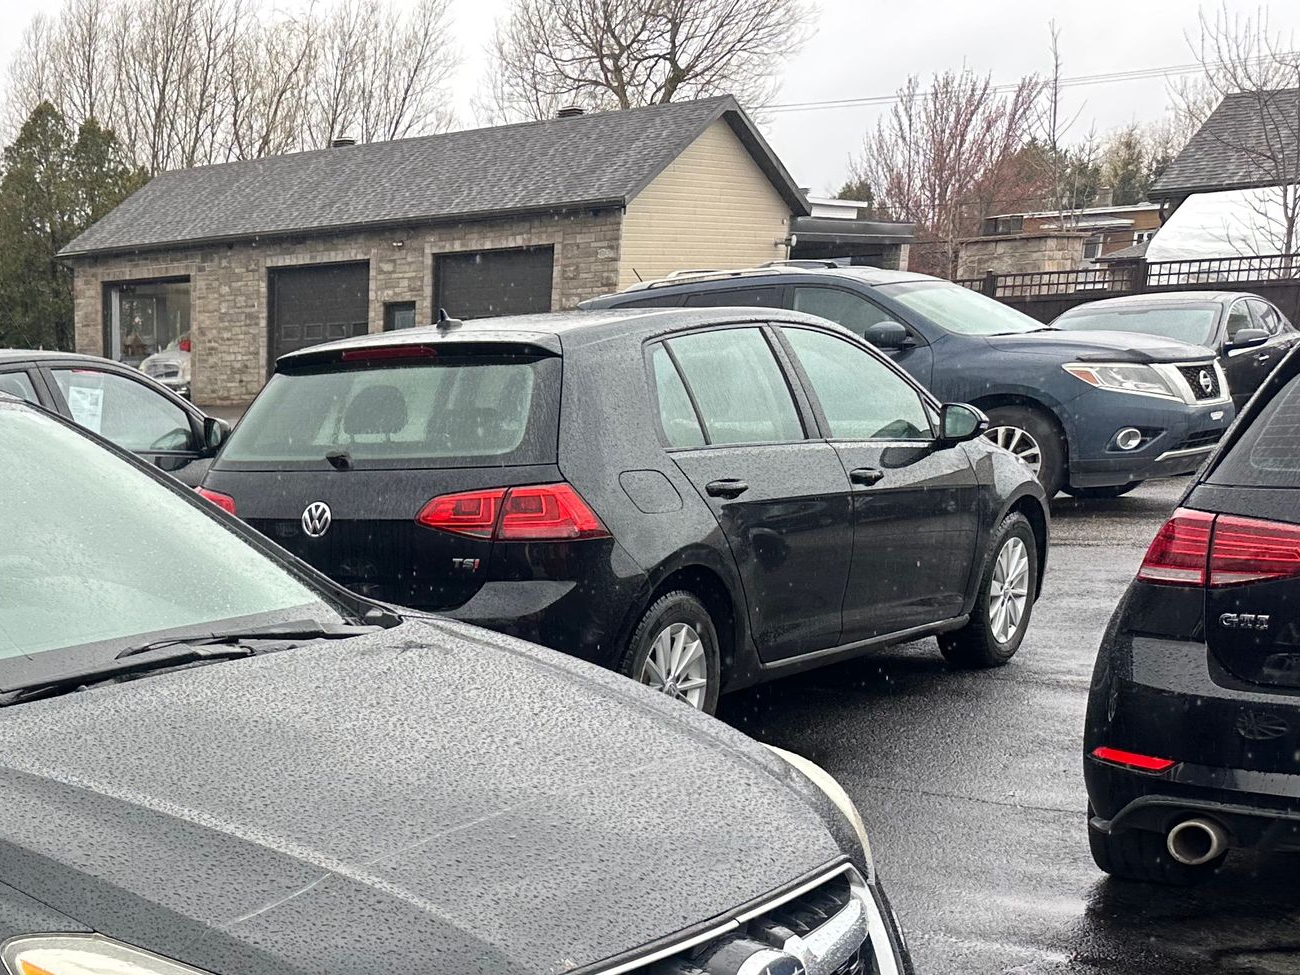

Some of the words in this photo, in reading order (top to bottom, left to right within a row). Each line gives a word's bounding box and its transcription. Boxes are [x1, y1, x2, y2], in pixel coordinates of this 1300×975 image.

[302, 501, 332, 538] VW
[452, 557, 480, 570] TSI
[1219, 612, 1270, 629] GTI
